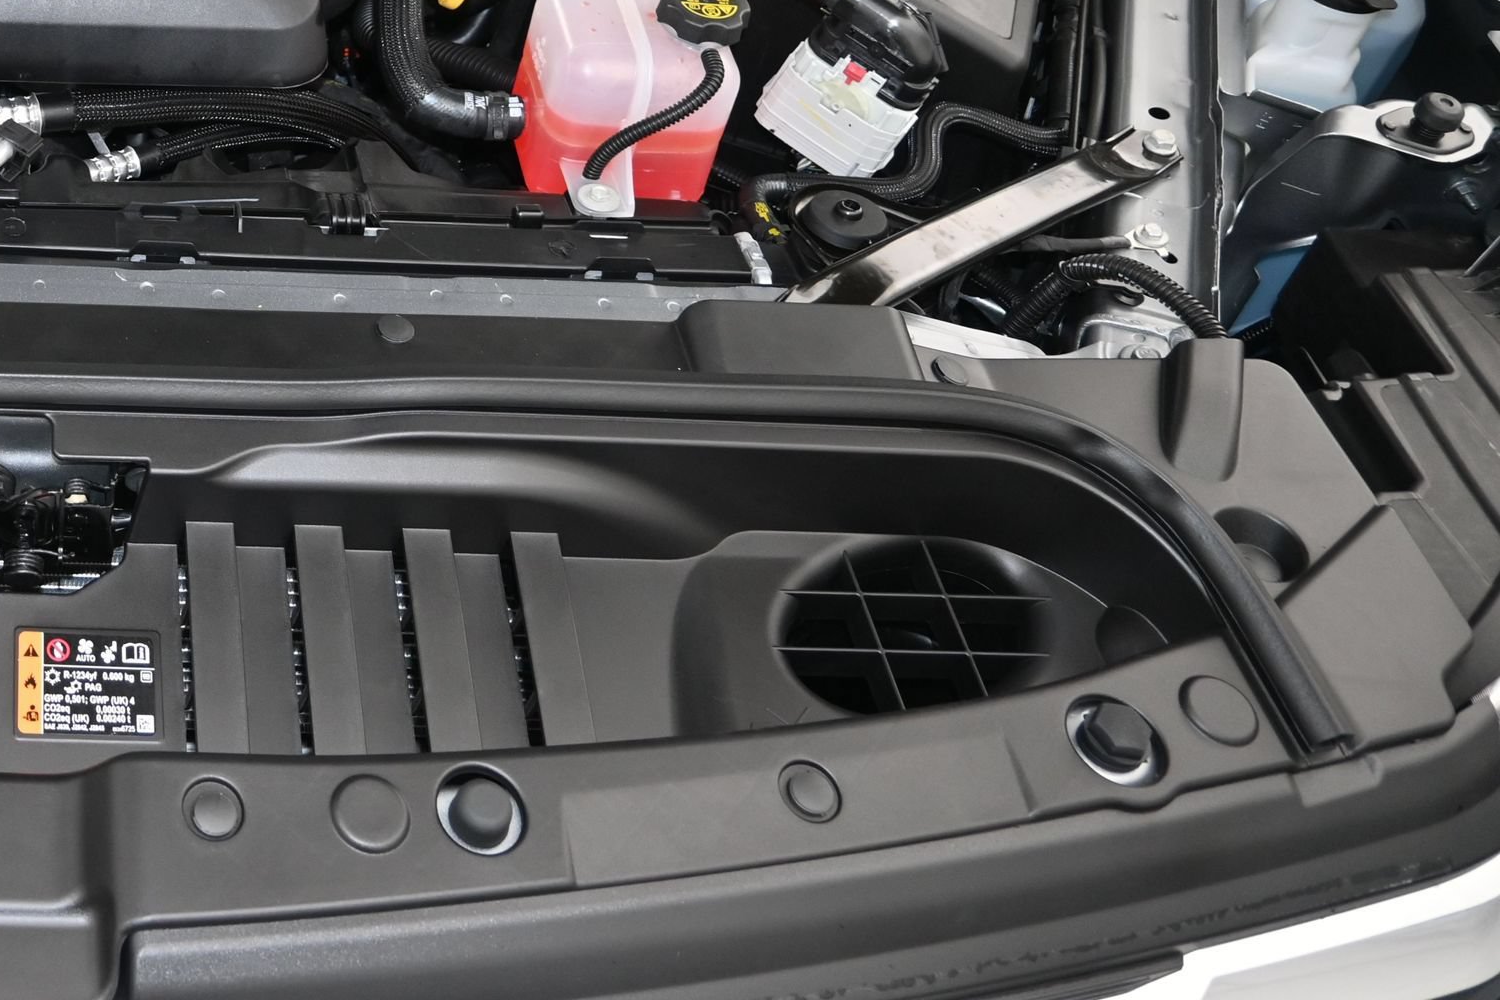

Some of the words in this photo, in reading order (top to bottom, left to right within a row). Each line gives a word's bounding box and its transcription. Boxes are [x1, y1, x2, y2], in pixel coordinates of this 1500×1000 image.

[76, 654, 96, 663] AUTO
[63, 670, 97, 681] R-1234yf
[124, 672, 135, 683] kg
[84, 683, 103, 692] PAG
[44, 694, 63, 703] GWP
[89, 695, 109, 704] GWP
[111, 696, 128, 706] (UK)
[129, 696, 135, 705] 4
[44, 704, 71, 714] CO2eq
[44, 713, 71, 723] CO2eq
